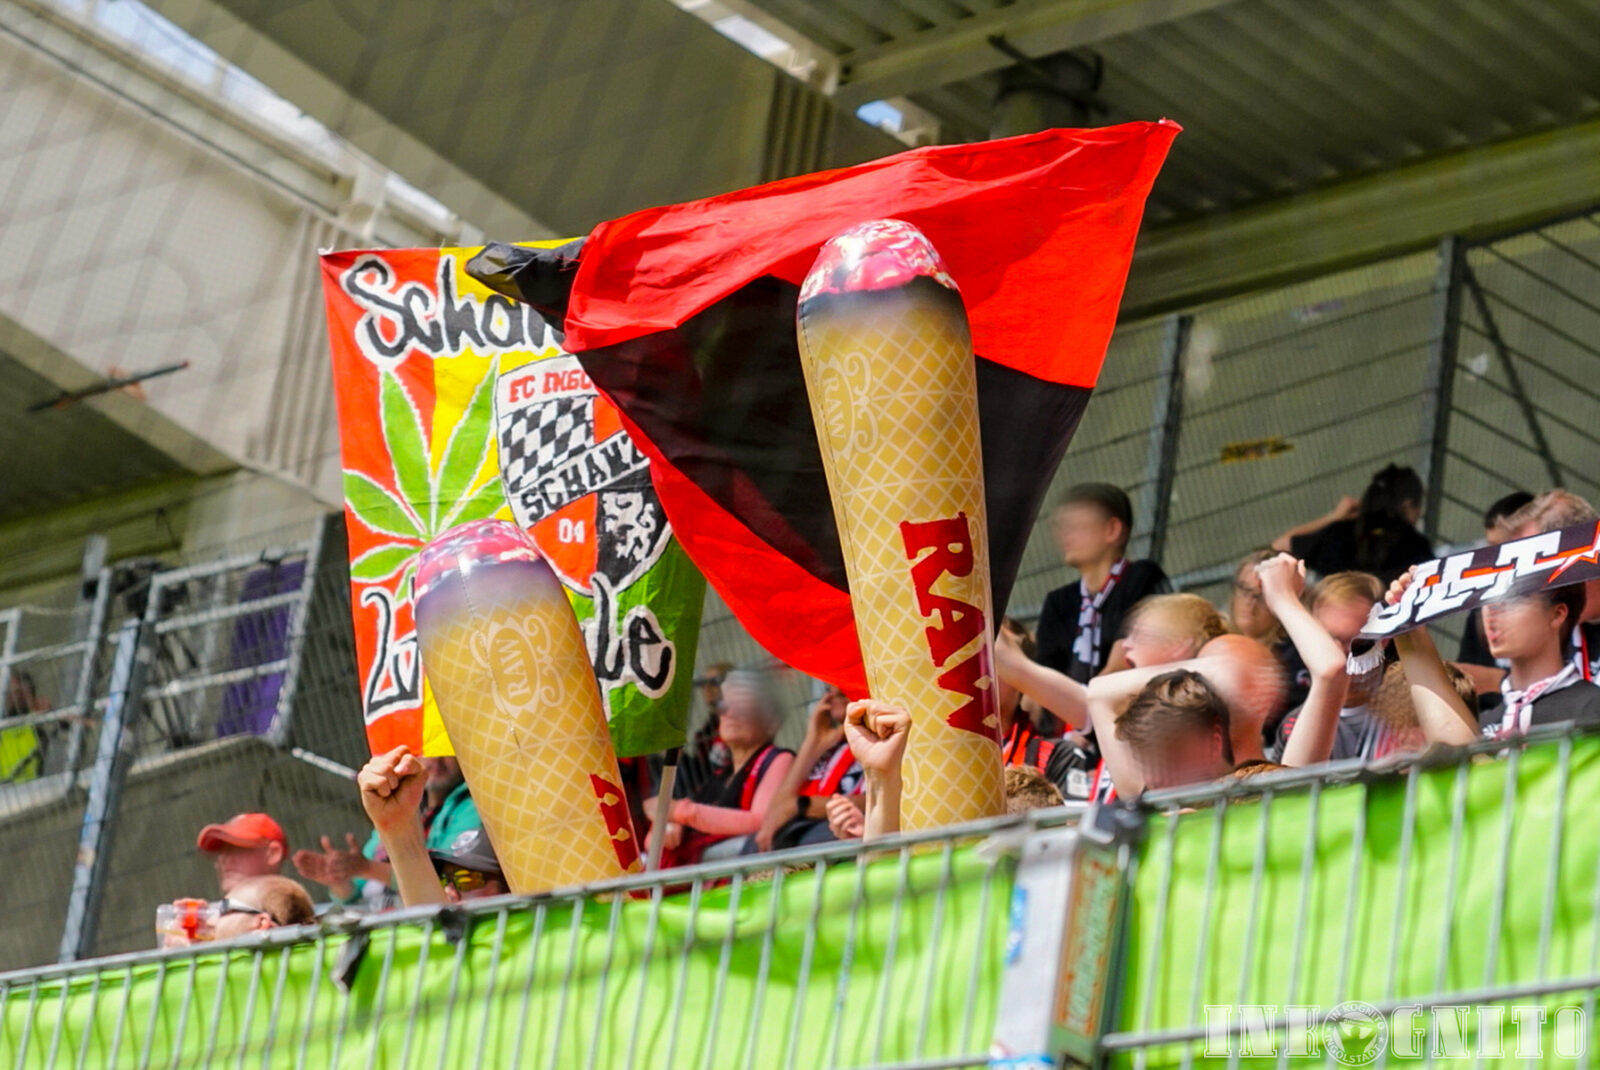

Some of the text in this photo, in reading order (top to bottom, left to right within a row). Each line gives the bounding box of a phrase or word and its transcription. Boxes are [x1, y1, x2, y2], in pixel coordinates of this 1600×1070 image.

[509, 375, 535, 403] FC
[823, 375, 847, 438] RAW
[559, 518, 585, 544] 04
[899, 511, 1001, 748] RAW
[496, 638, 531, 698] RAW
